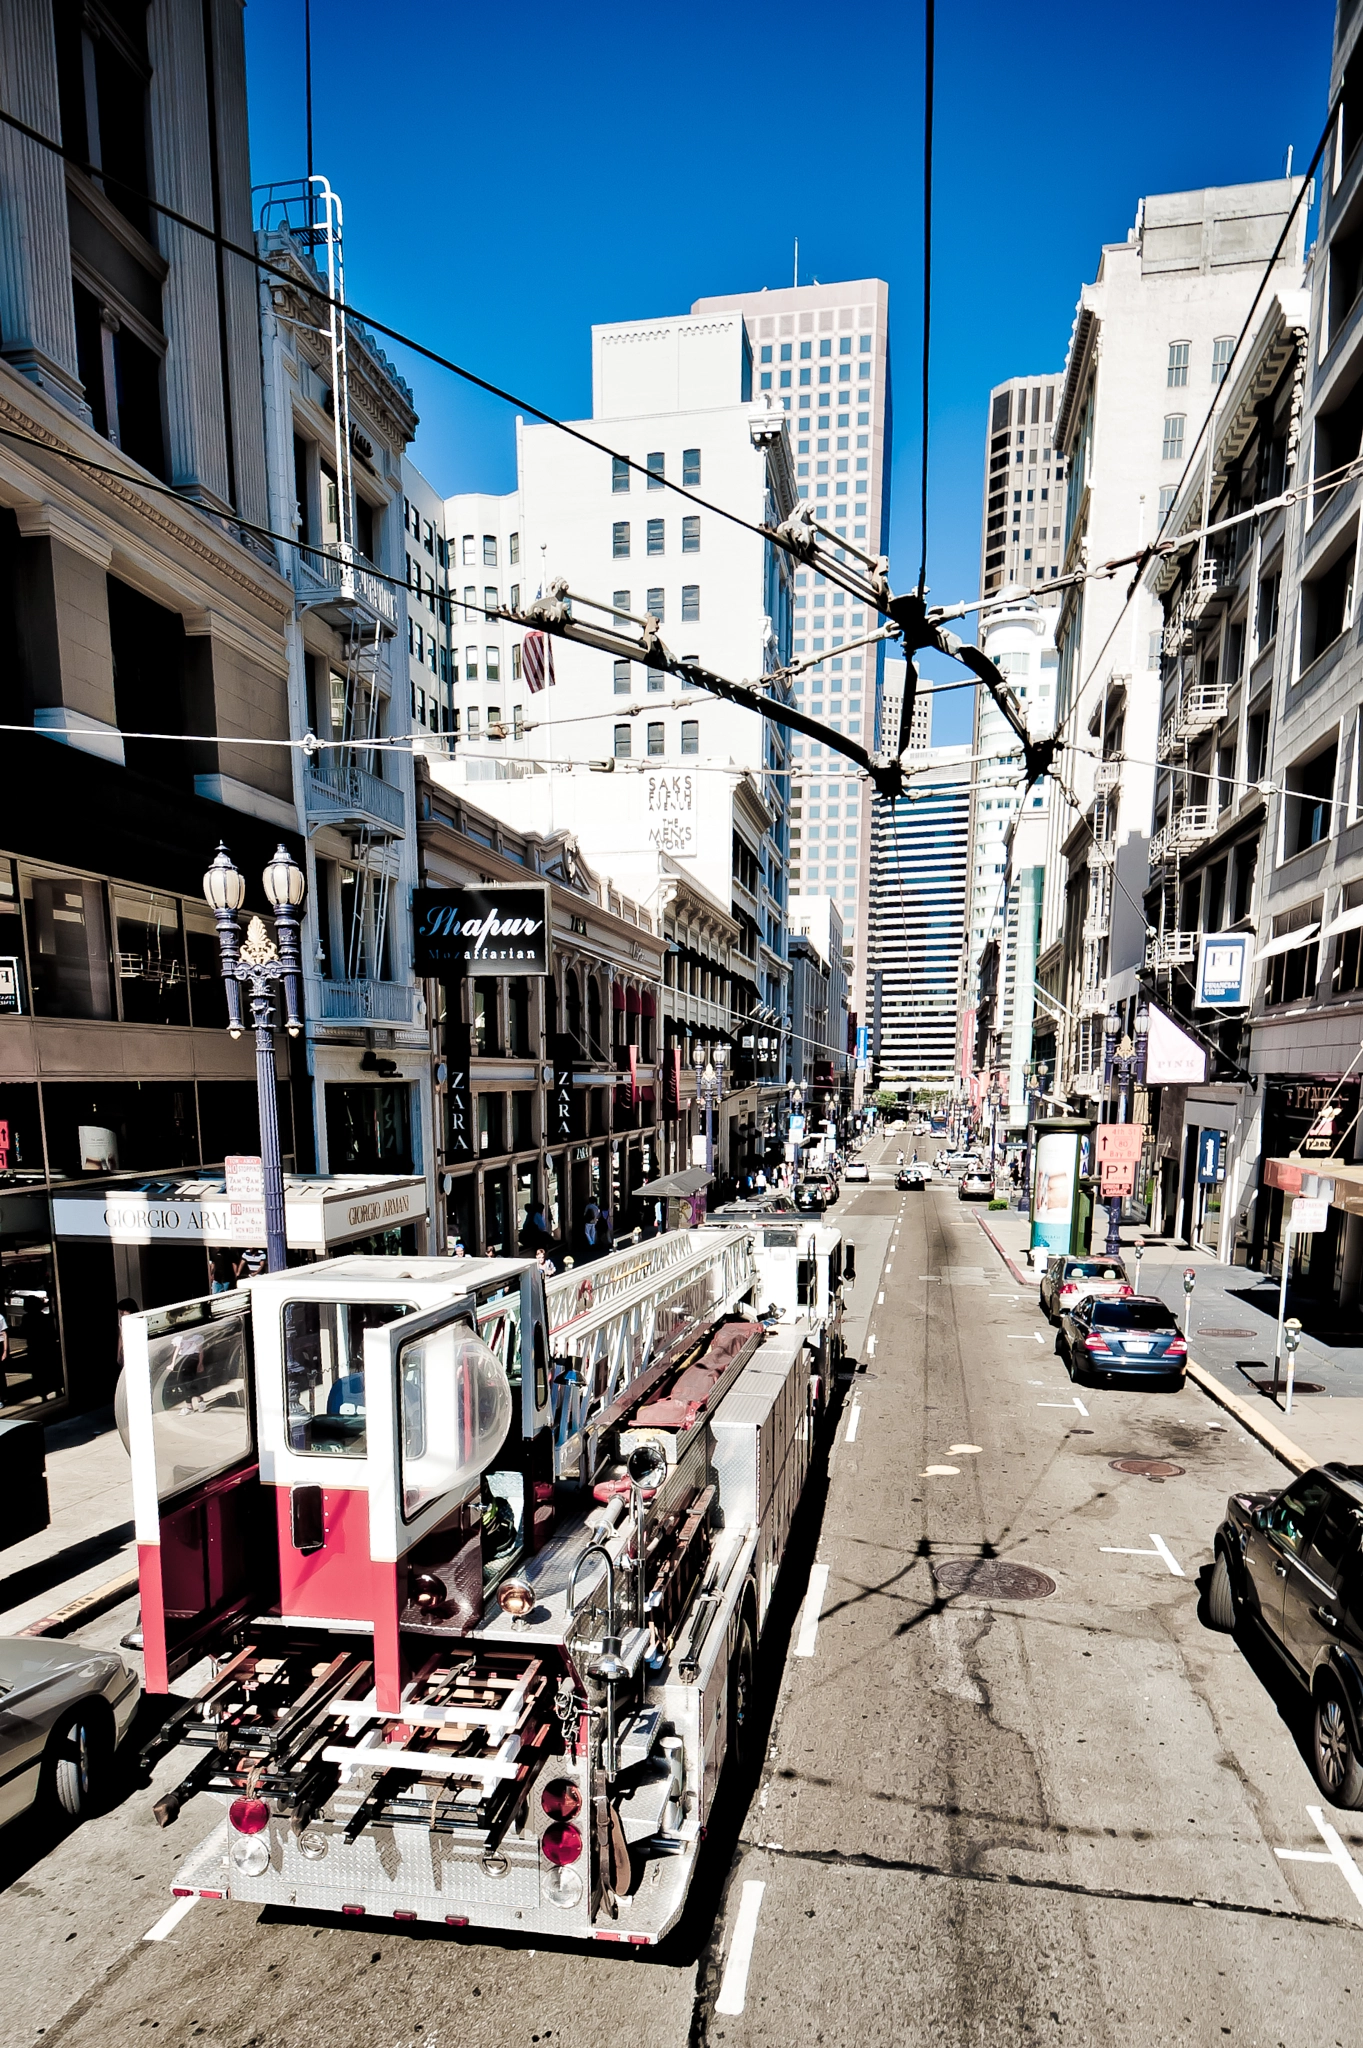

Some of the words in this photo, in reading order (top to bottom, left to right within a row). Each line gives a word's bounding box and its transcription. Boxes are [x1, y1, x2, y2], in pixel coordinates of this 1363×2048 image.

[648, 775, 692, 791] SAKS
[648, 790, 692, 803] FIFTH
[648, 801, 692, 811] AVENUE
[662, 818, 679, 828] THE
[648, 827, 692, 841] MEN'S
[656, 840, 685, 850] STORE
[419, 906, 543, 949] Shapur
[428, 947, 536, 960] Mozaffarian
[1210, 951, 1240, 967] FT
[1204, 981, 1240, 989] FINANCIAL
[1204, 988, 1226, 996] TIMES
[1158, 1060, 1195, 1069] PINK
[558, 1072, 571, 1133] ZARA
[1294, 1086, 1333, 1109] PINK
[451, 1072, 469, 1149] ZARA
[227, 1165, 237, 1174] NO
[238, 1165, 261, 1173] STOPPING
[231, 1204, 241, 1215] NO
[242, 1206, 264, 1215] PARKING
[348, 1201, 381, 1226] GIORGIO
[382, 1194, 409, 1218] ARMANI
[103, 1209, 180, 1230] GIORGIO
[187, 1210, 231, 1231] ARM
